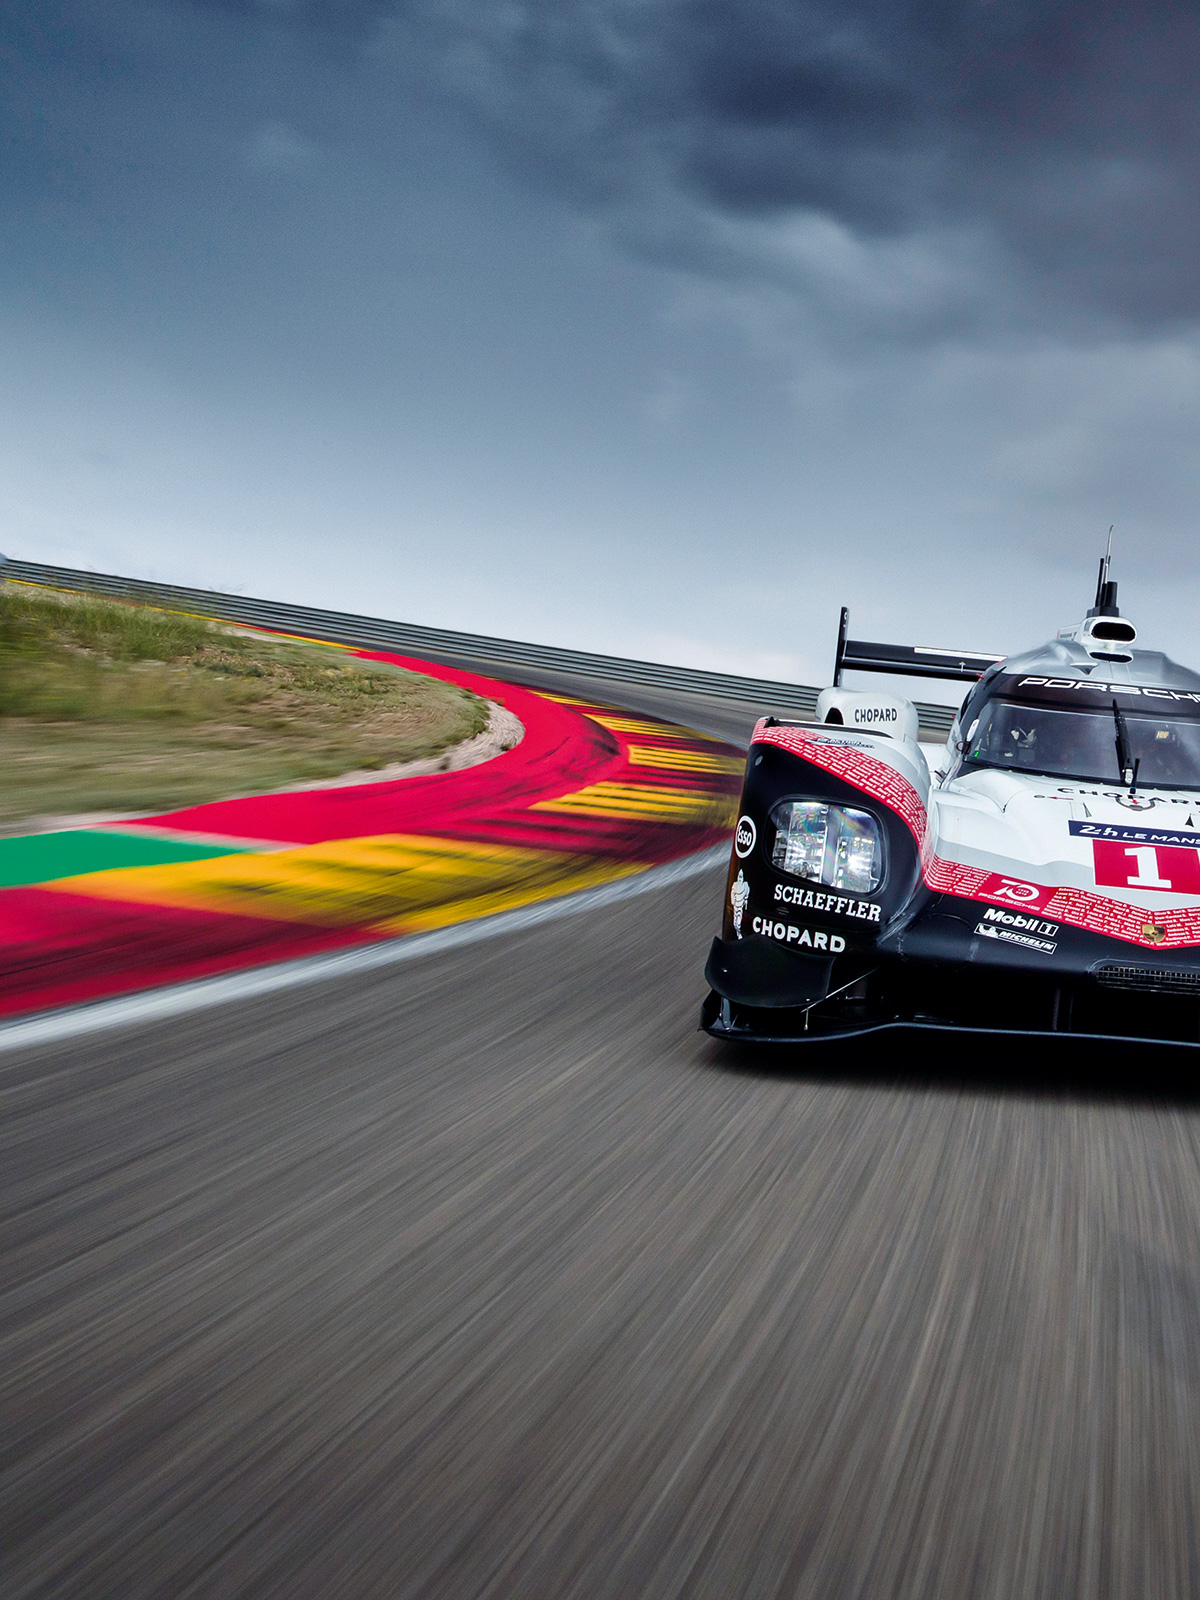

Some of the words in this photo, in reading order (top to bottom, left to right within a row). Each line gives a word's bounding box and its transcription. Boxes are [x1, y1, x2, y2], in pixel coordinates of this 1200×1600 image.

[855, 708, 897, 723] CHOPARD
[1122, 832, 1147, 840] LE
[1124, 847, 1172, 889] 1
[774, 884, 882, 922] SCHAEFFLER
[978, 893, 1041, 911] PORSCHE
[983, 908, 1040, 931] Mobil
[752, 916, 846, 953] CHOPARD
[999, 931, 1054, 950] MICHELIN
